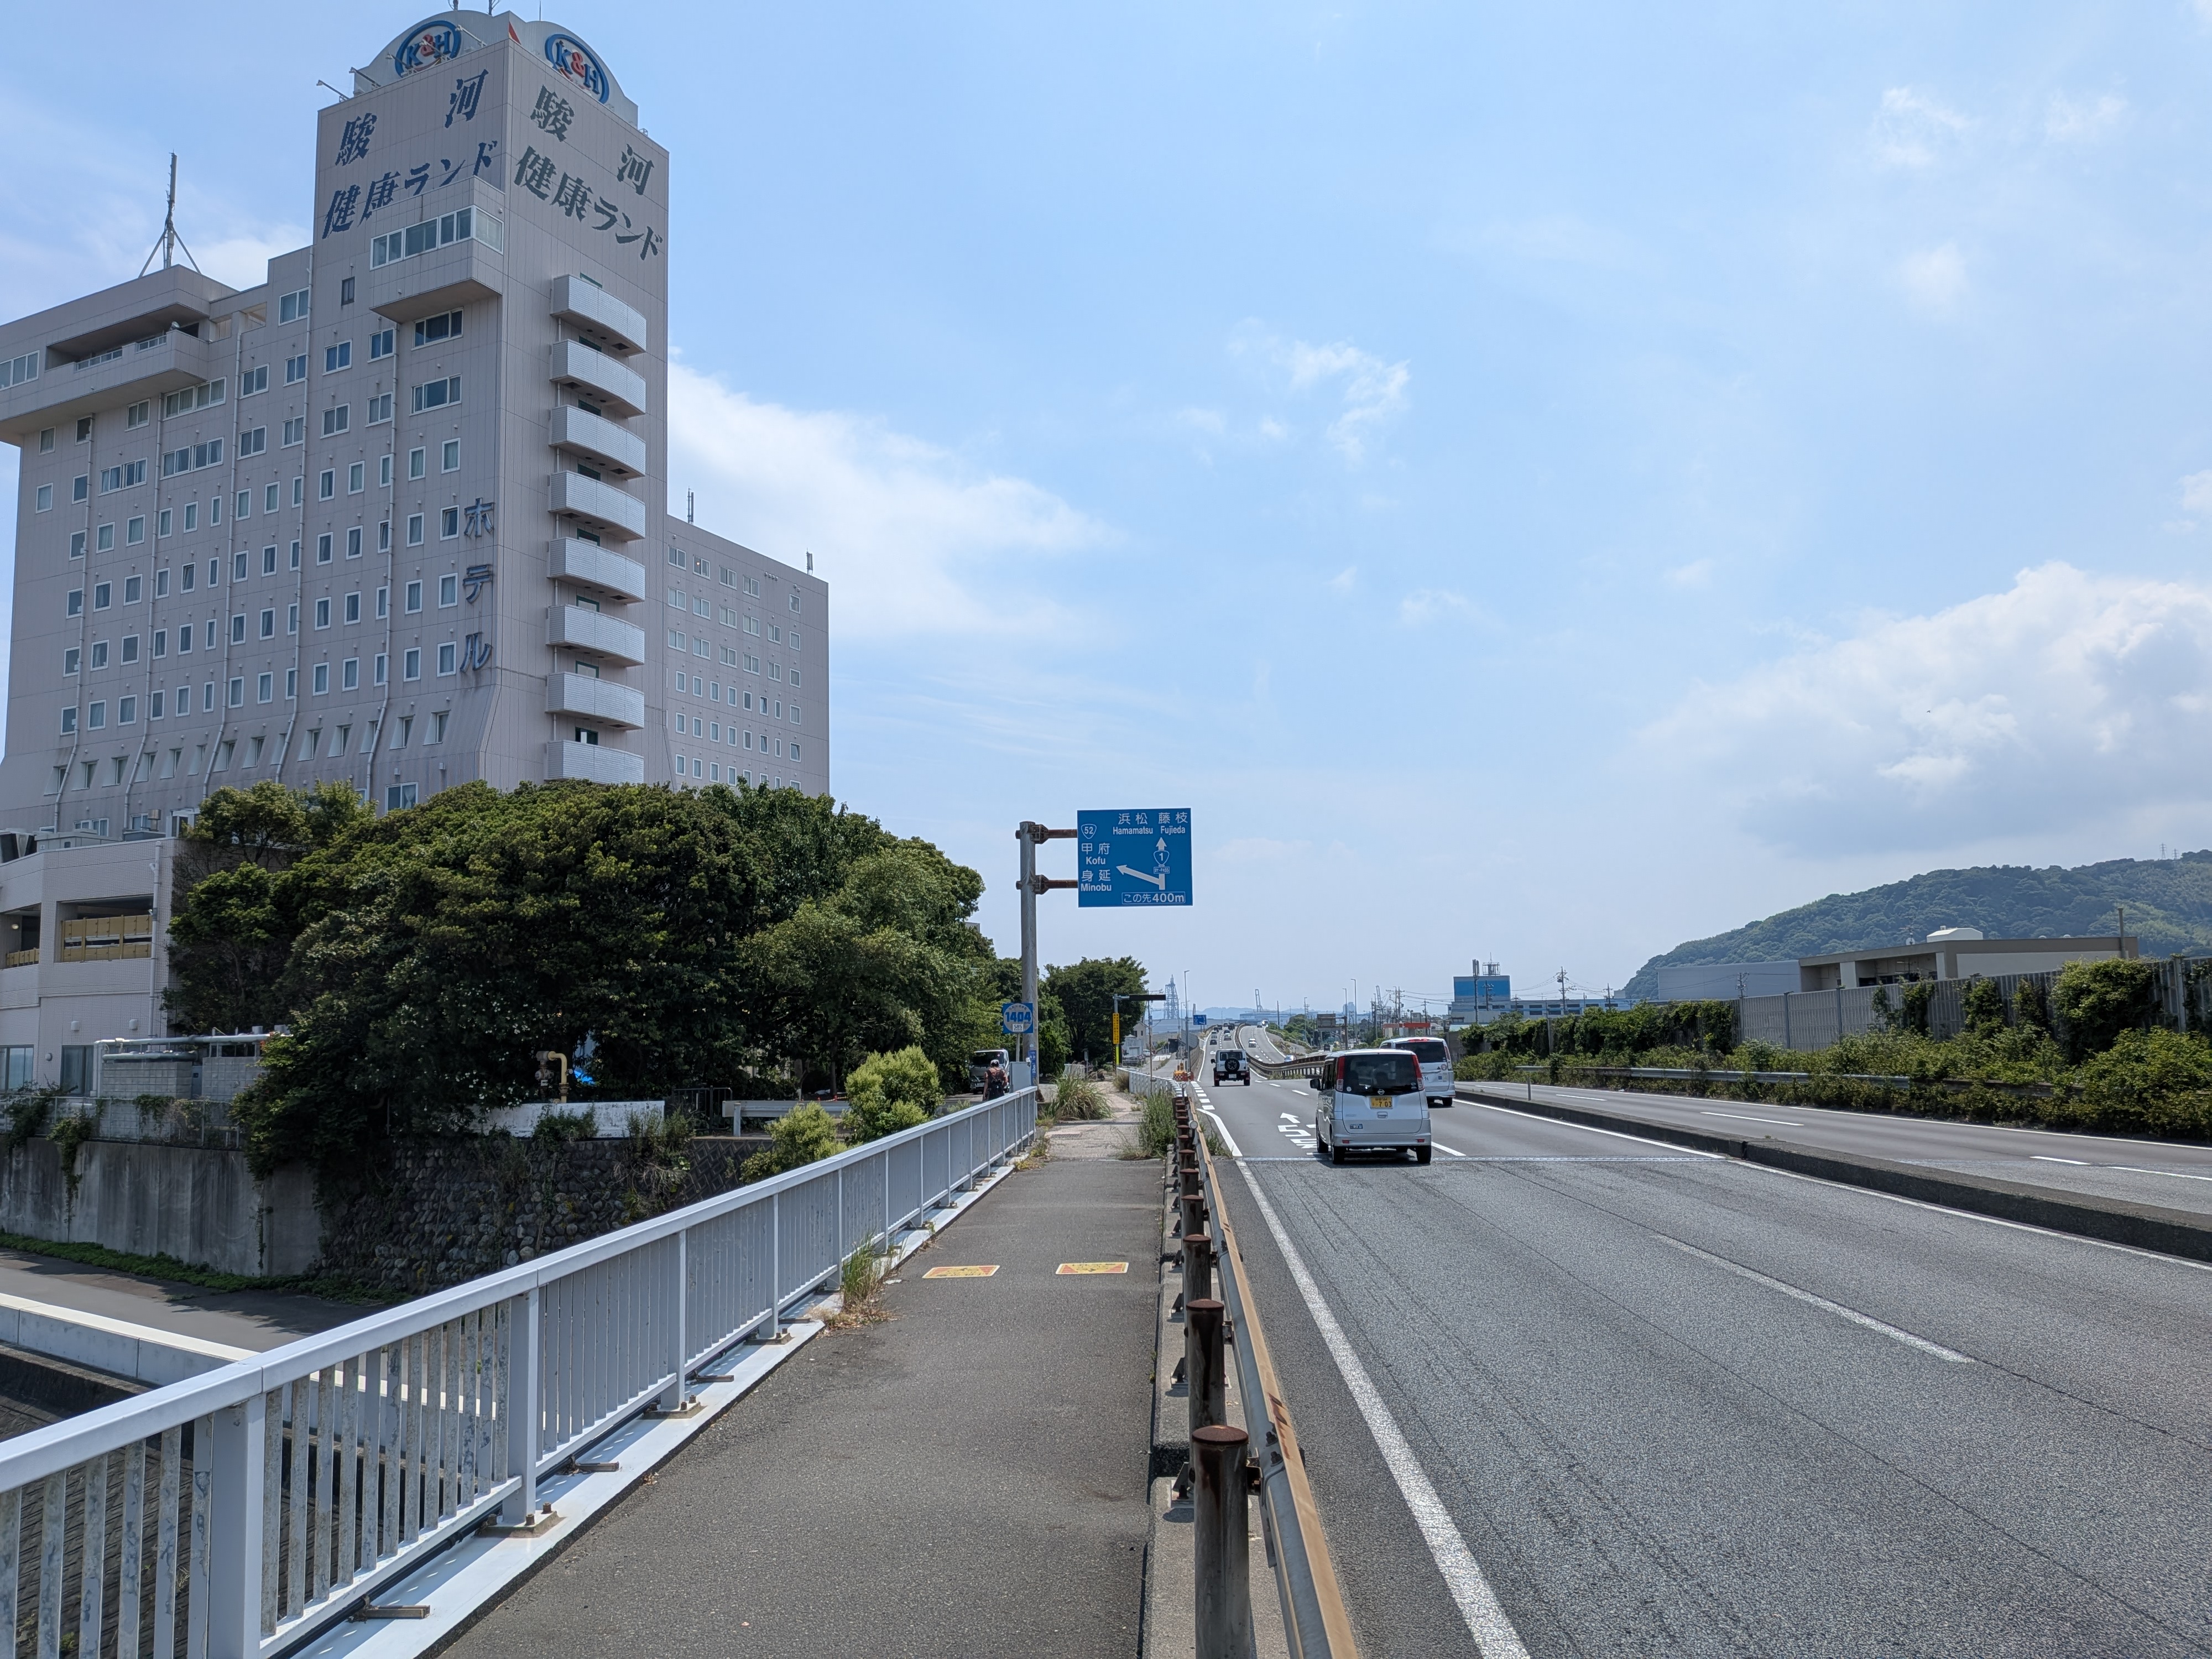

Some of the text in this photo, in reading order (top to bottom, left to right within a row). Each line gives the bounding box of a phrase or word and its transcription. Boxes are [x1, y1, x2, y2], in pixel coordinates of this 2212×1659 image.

[404, 29, 451, 69] K&H
[552, 40, 601, 95] K&H
[322, 140, 498, 239] 健康ランド
[514, 145, 663, 260] 健康ランド
[460, 497, 495, 672] ホテル
[1118, 812, 1188, 825] 浜松 藤枝
[1160, 826, 1186, 836] Fujieda
[1082, 843, 1110, 855] 甲府
[1086, 857, 1106, 865] Kofu
[1159, 853, 1164, 861] 1
[1081, 869, 1111, 882] 身延
[1081, 883, 1112, 891] Minobu
[1005, 1012, 1031, 1022] 1404
